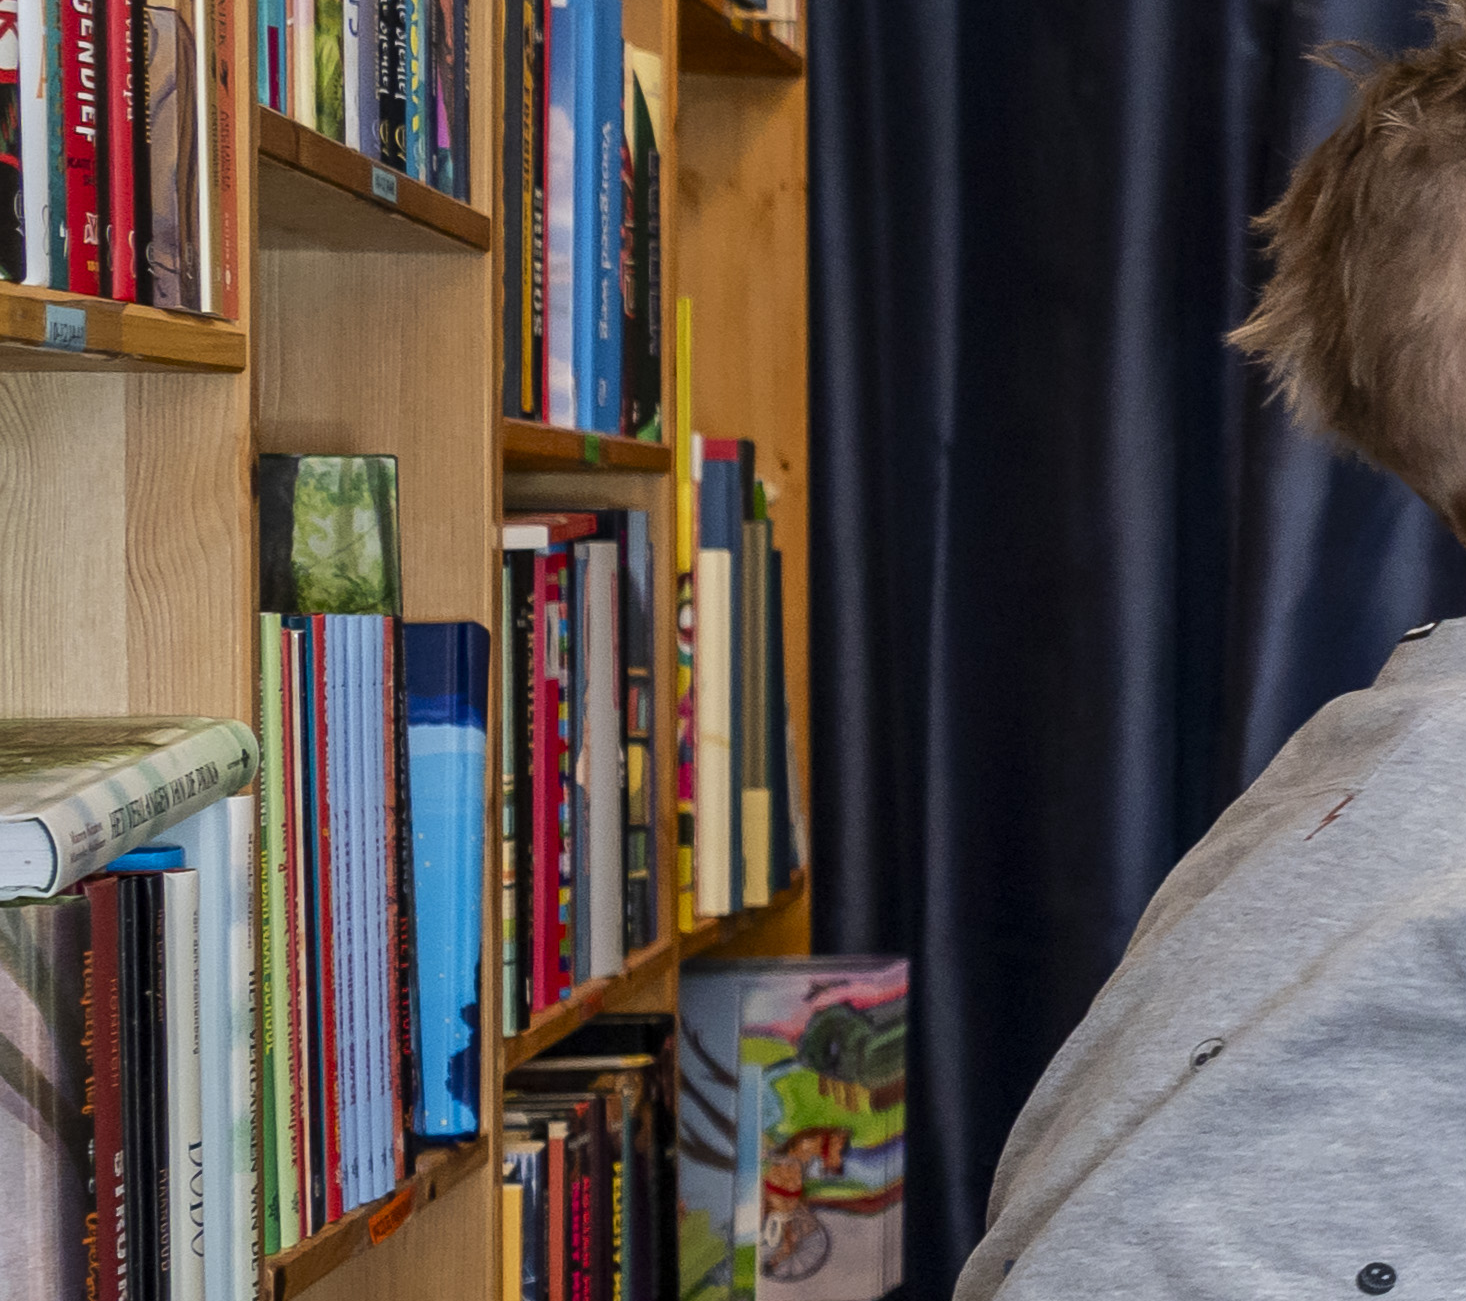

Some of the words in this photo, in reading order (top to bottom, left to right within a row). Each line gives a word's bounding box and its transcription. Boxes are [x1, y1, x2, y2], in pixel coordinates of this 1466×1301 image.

[599, 121, 612, 269] Voorgoed
[599, 278, 610, 340] weg
[249, 968, 257, 1016] HET
[189, 1141, 204, 1259] DODO
[612, 1161, 623, 1264] FELICITY
